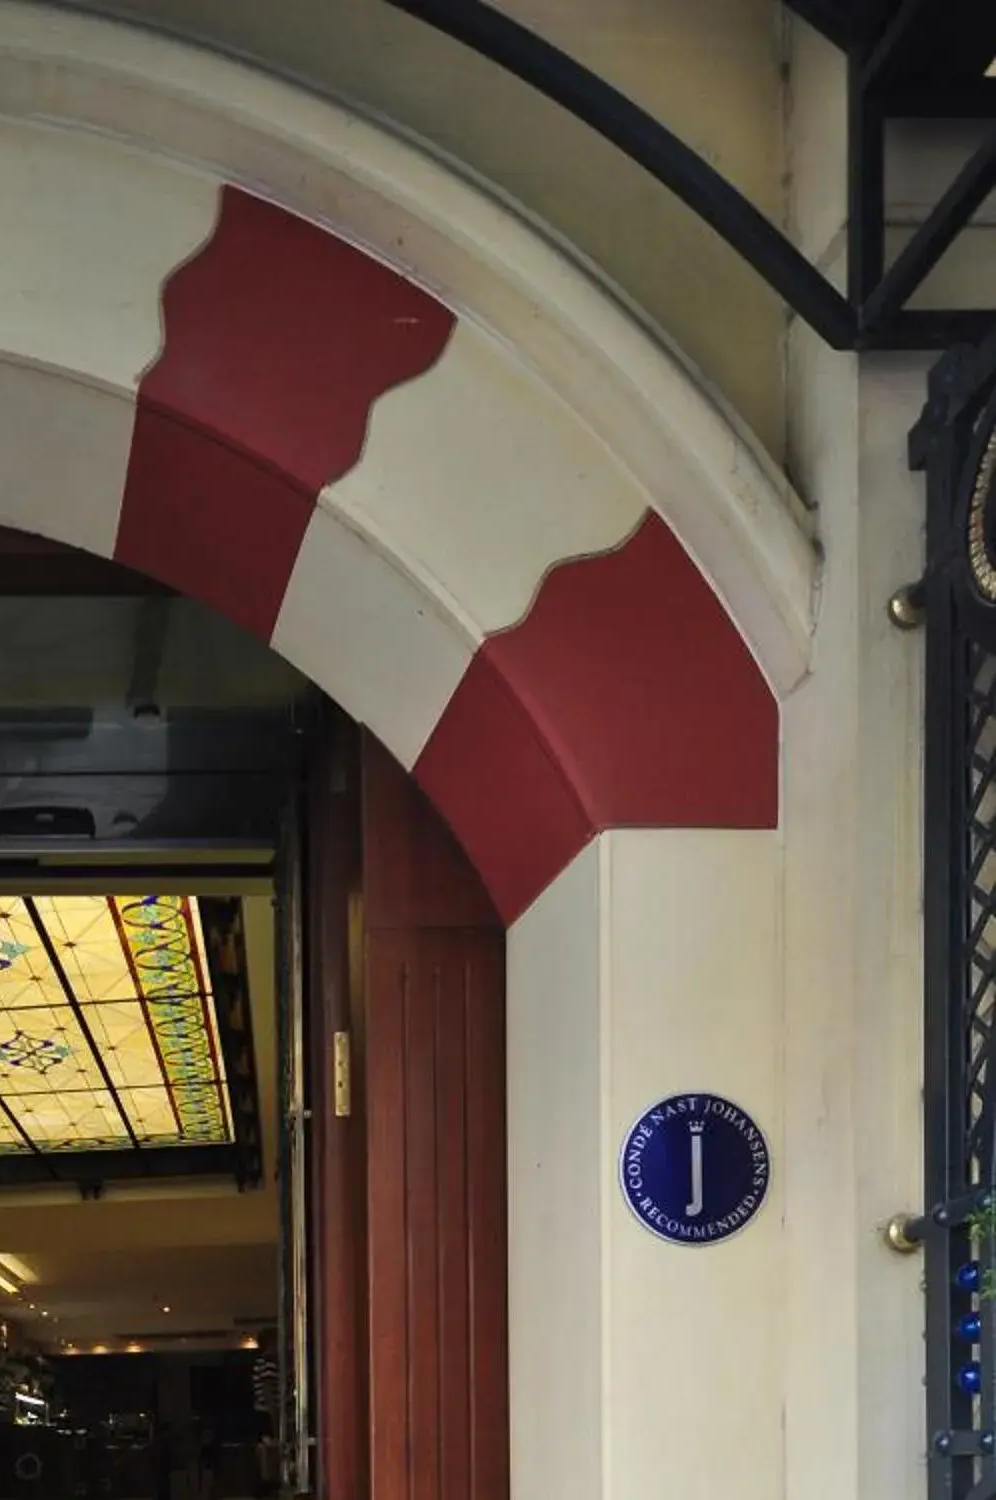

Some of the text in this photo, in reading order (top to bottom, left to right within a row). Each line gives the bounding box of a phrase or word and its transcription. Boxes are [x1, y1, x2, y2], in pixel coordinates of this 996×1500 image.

[651, 1098, 697, 1125] NAST
[704, 1099, 767, 1186] JOHANSENS
[640, 1195, 755, 1238] RECOMMENDED
